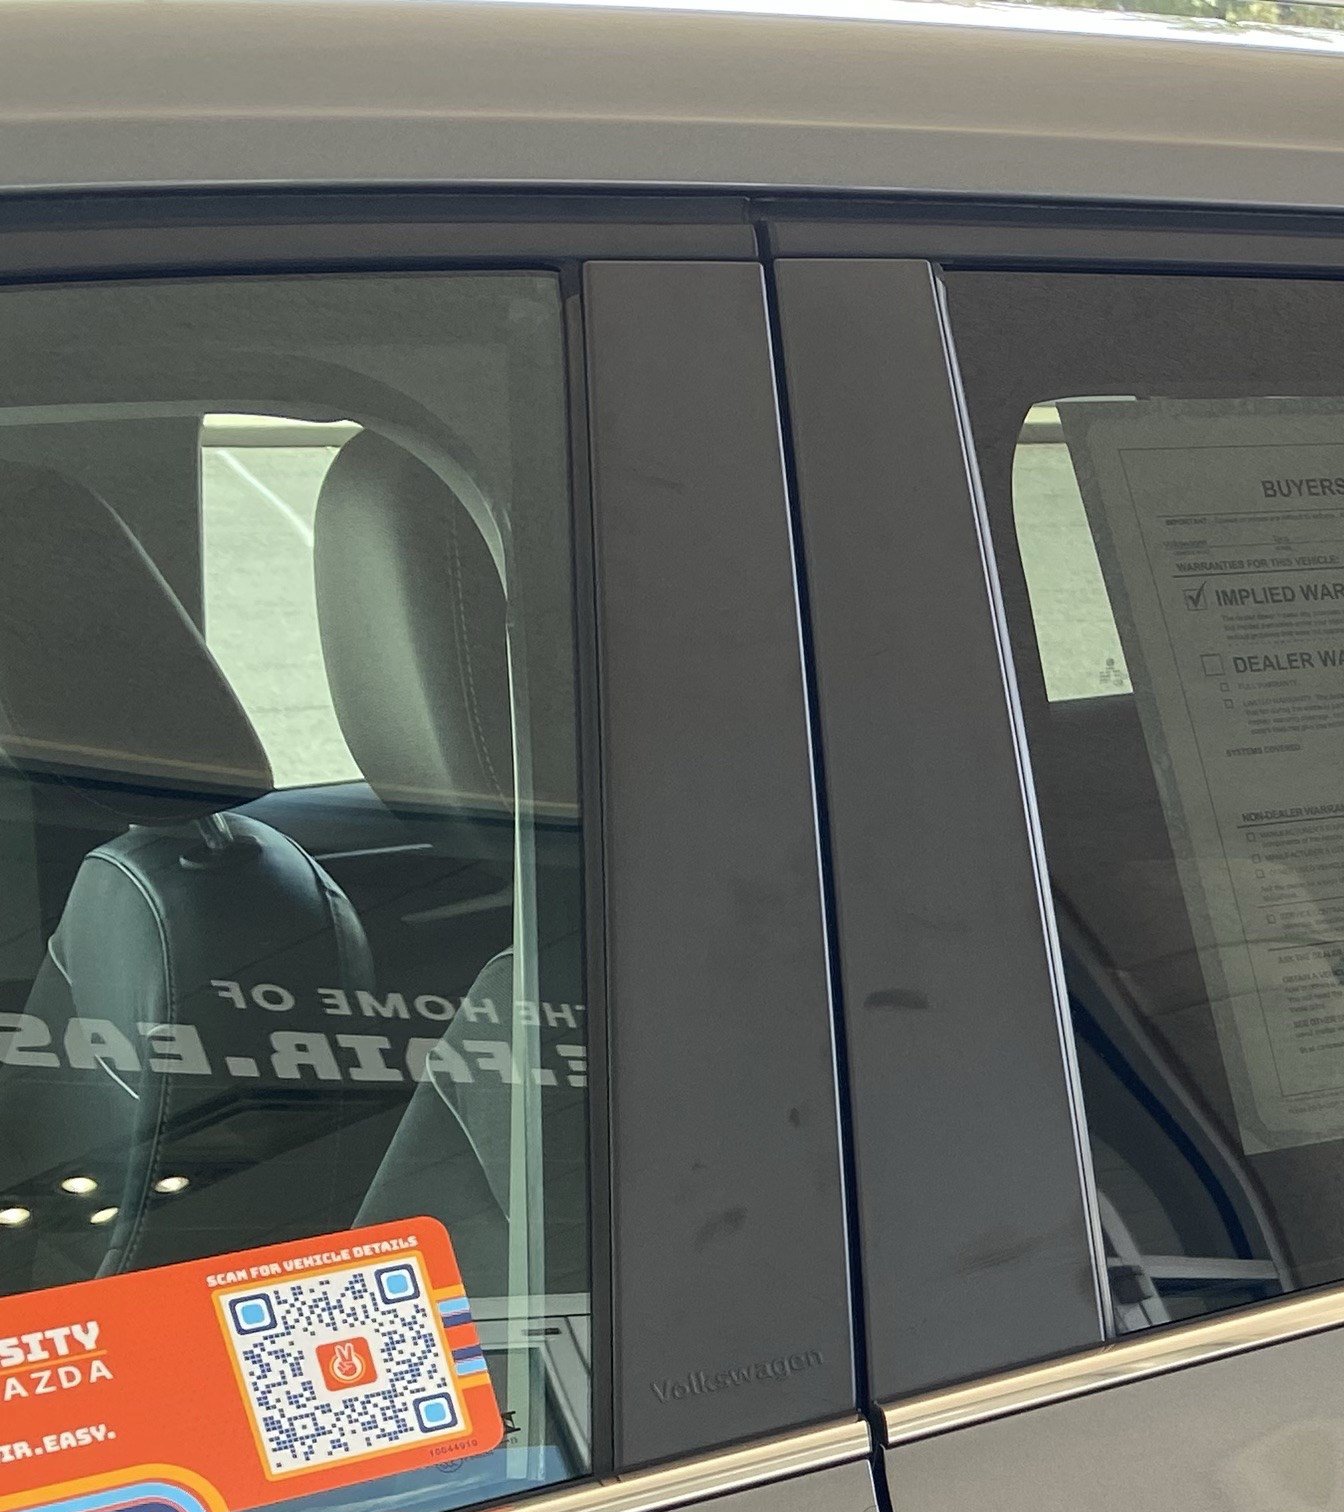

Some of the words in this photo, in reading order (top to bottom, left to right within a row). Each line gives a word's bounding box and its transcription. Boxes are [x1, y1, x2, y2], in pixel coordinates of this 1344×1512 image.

[1176, 559, 1245, 573] WARRANTIES
[1247, 558, 1269, 569] FOR
[1270, 556, 1293, 567] THIS
[1296, 554, 1340, 566] VEHICLE:
[1215, 585, 1296, 607] IMPLIED
[1233, 651, 1315, 674] DEALER
[1242, 807, 1302, 823] NON-DEALER
[206, 1269, 248, 1288] SCAN
[250, 1262, 282, 1279] FOR
[283, 1249, 351, 1273] VEHICLE
[352, 1235, 418, 1259] DETAILS
[650, 1349, 823, 1404] Volkswagen
